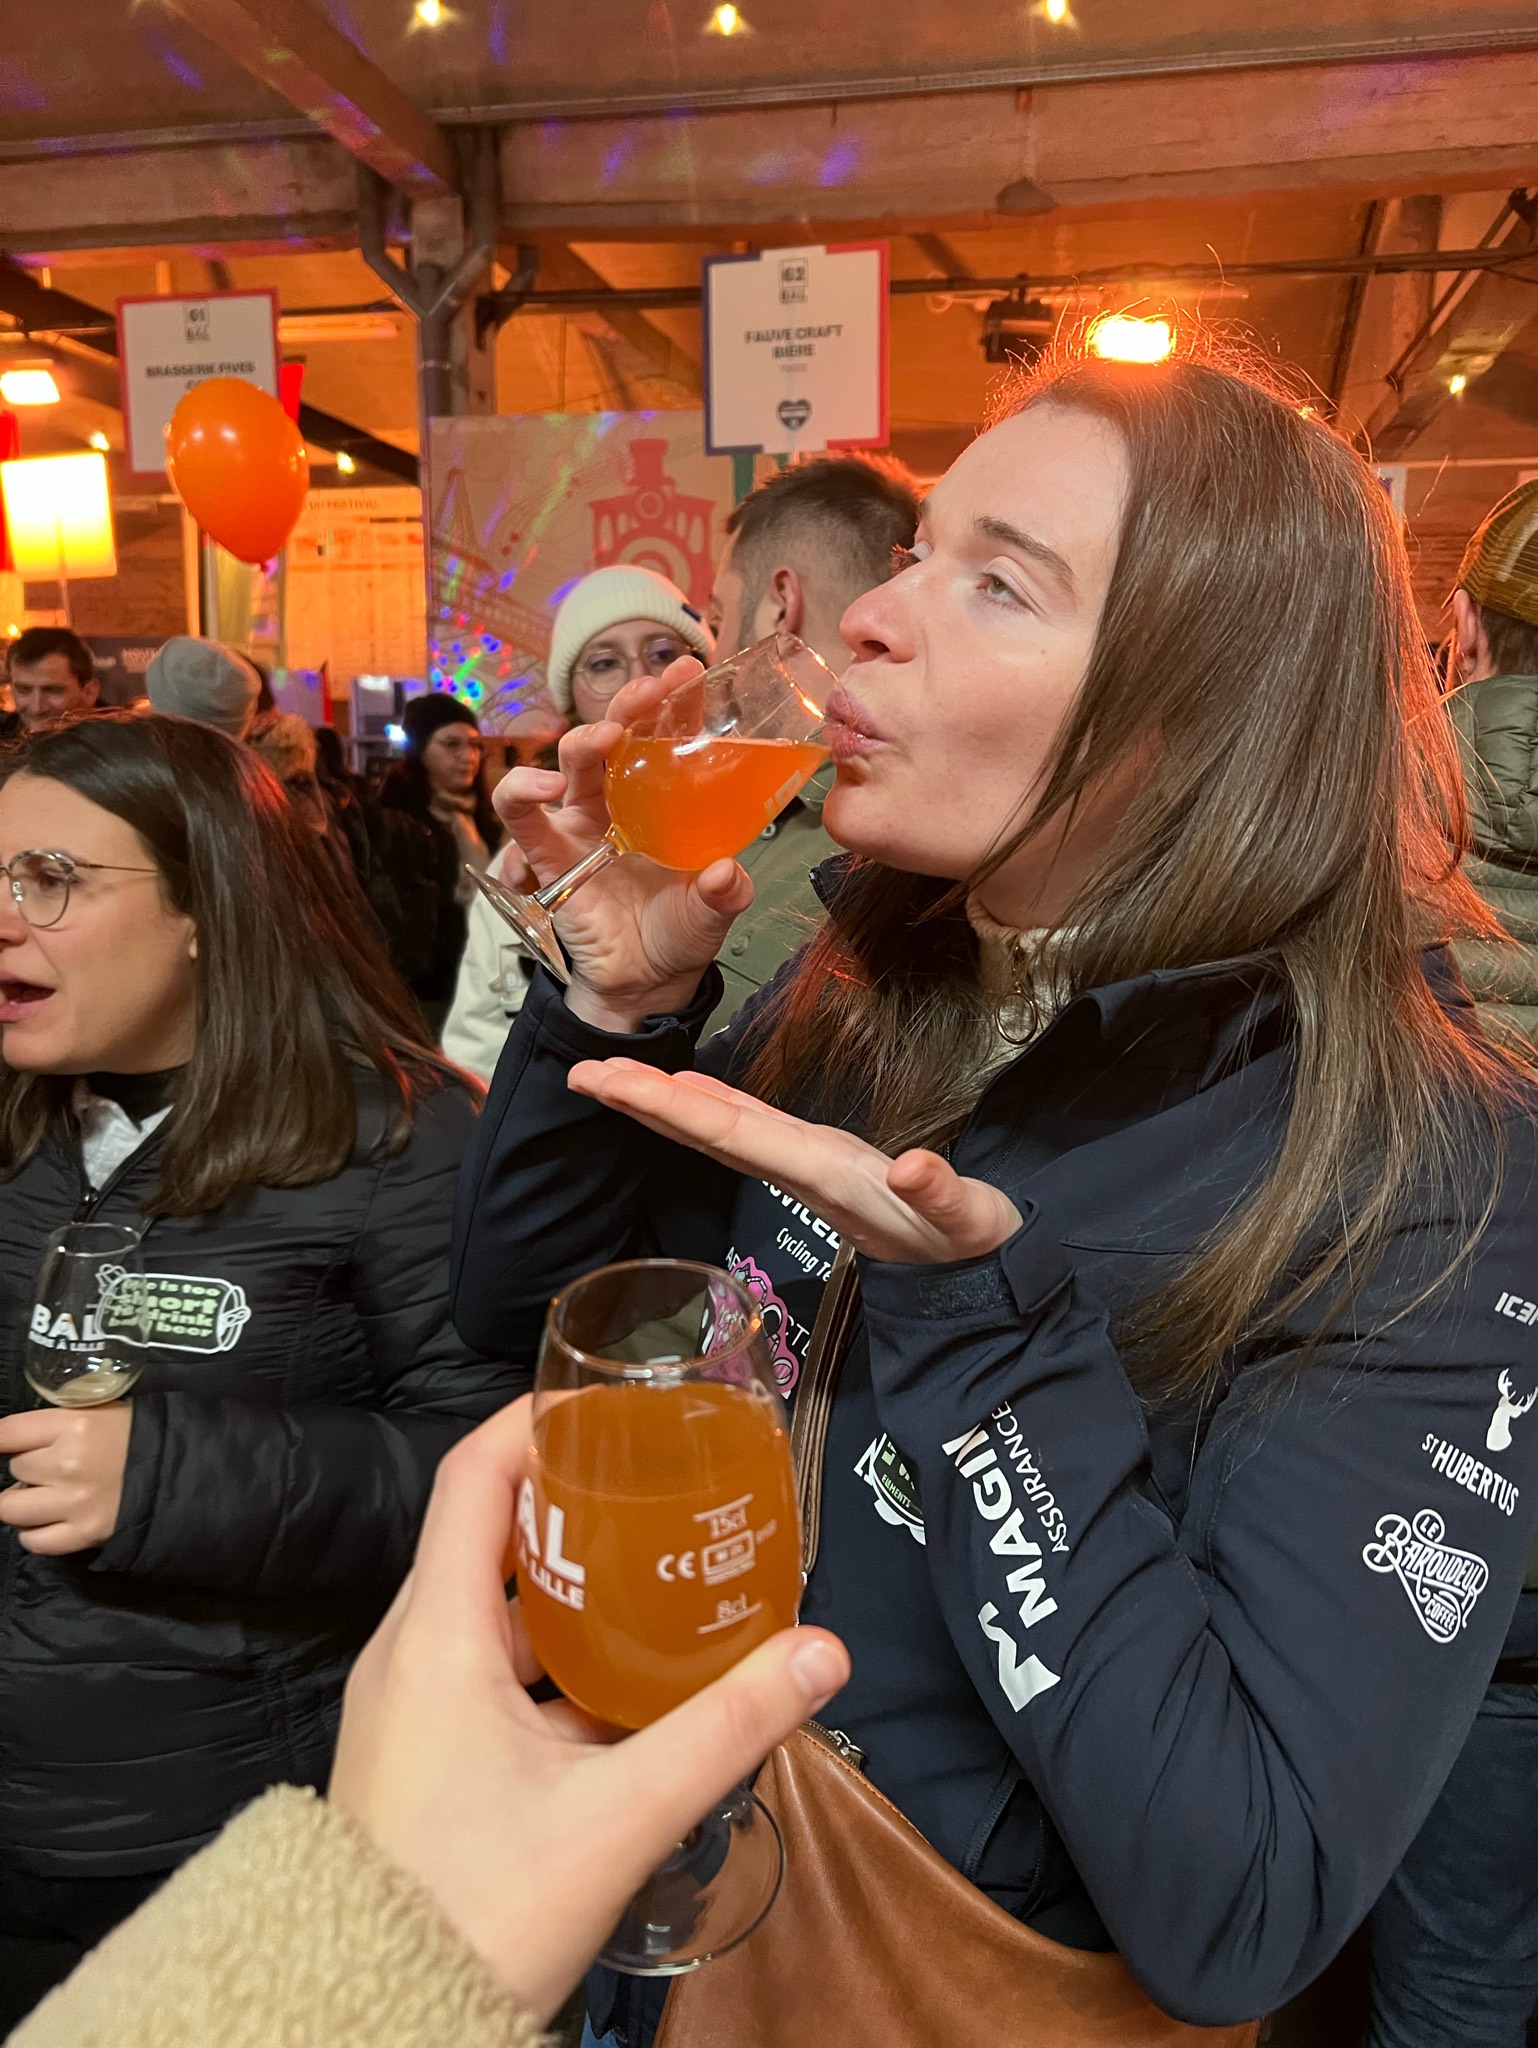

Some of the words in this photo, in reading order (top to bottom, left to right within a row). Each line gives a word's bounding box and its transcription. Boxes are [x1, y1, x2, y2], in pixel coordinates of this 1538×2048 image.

[784, 266, 806, 281] 62
[745, 328, 791, 343] FAUVE
[796, 324, 843, 339] CRAFT
[146, 363, 216, 377] BRASSERIE
[218, 361, 256, 374] FIVES
[776, 1227, 819, 1277] Cycling
[182, 1284, 221, 1297] too
[31, 1303, 105, 1341] BAL
[1431, 1440, 1519, 1516] HUBERTUS
[1420, 1516, 1440, 1539] LE
[1363, 1513, 1488, 1628] BAROUDEUR
[1424, 1599, 1458, 1631] COFFEE
